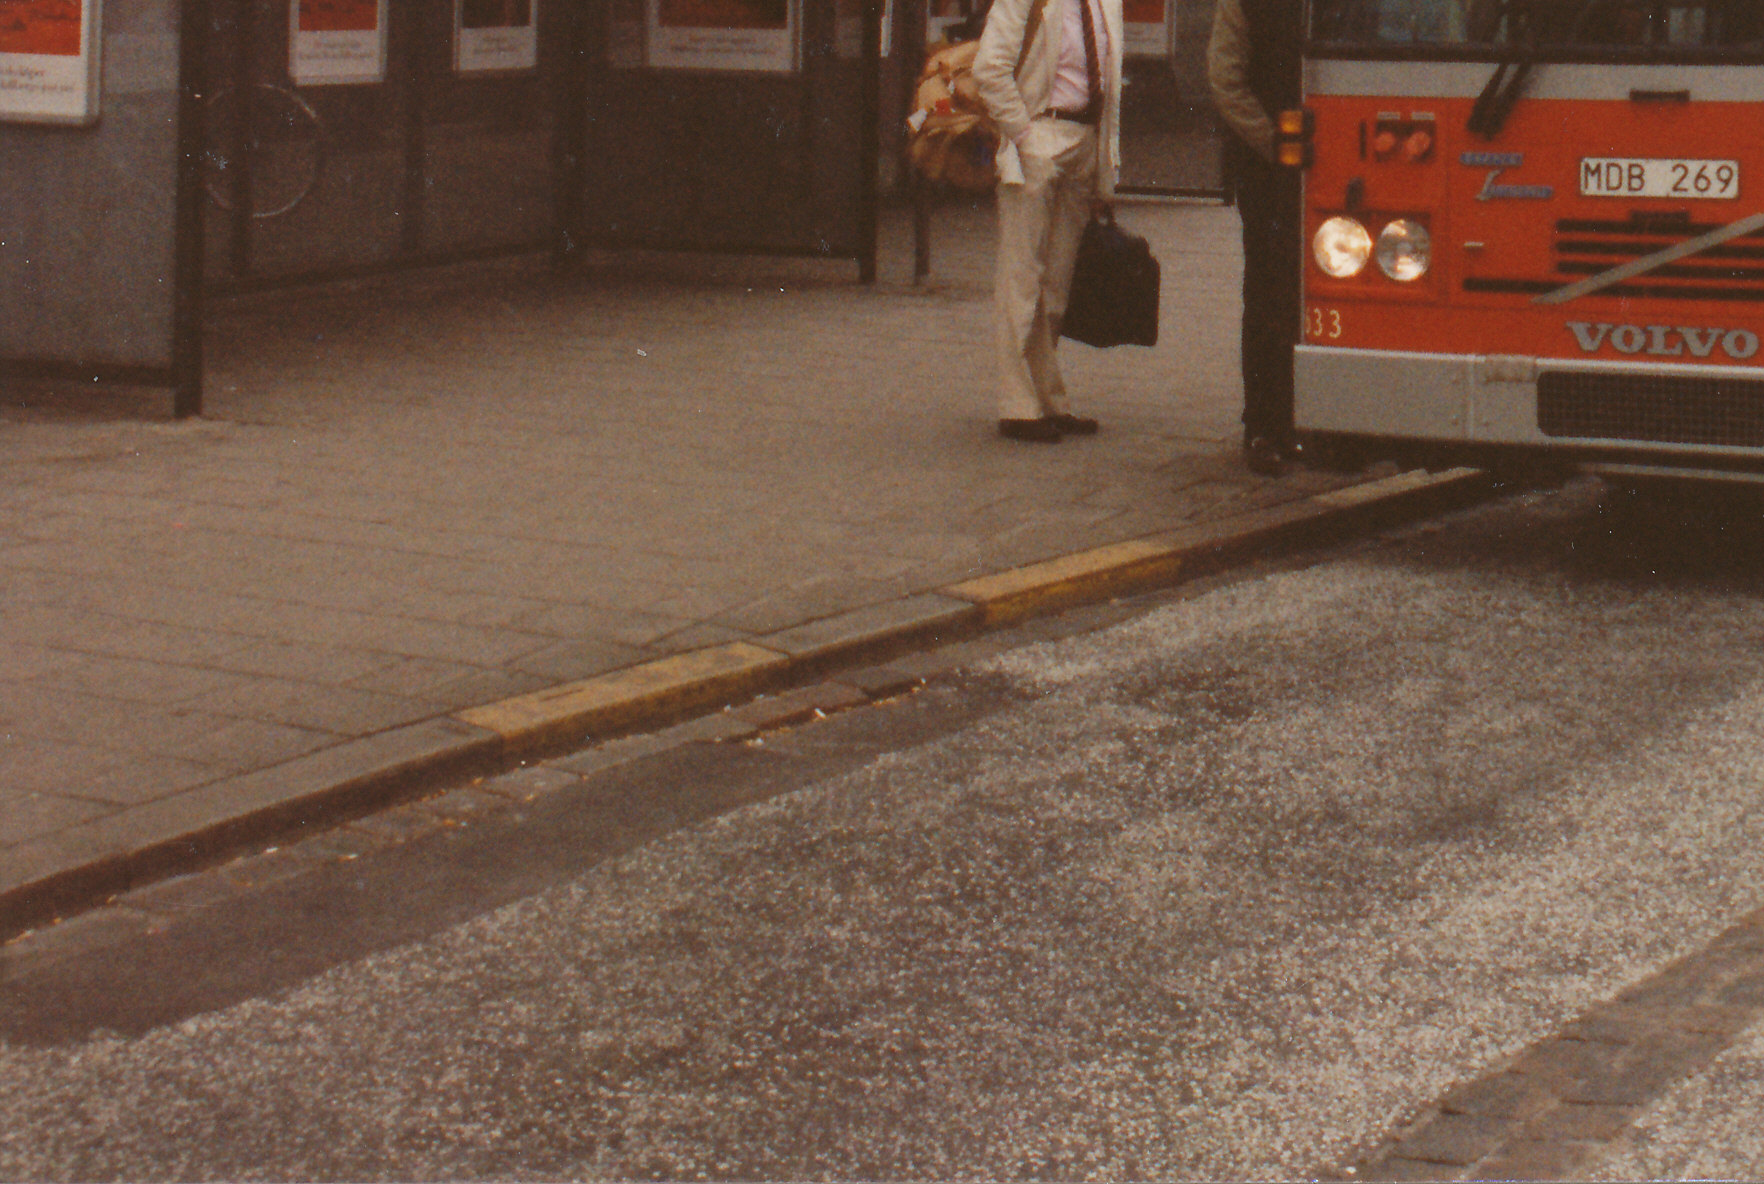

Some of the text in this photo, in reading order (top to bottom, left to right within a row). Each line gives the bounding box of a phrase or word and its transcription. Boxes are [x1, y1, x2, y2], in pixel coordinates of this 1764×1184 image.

[1582, 162, 1646, 191] MDB
[1670, 163, 1734, 193] 269
[1565, 320, 1761, 359] VOLVO
